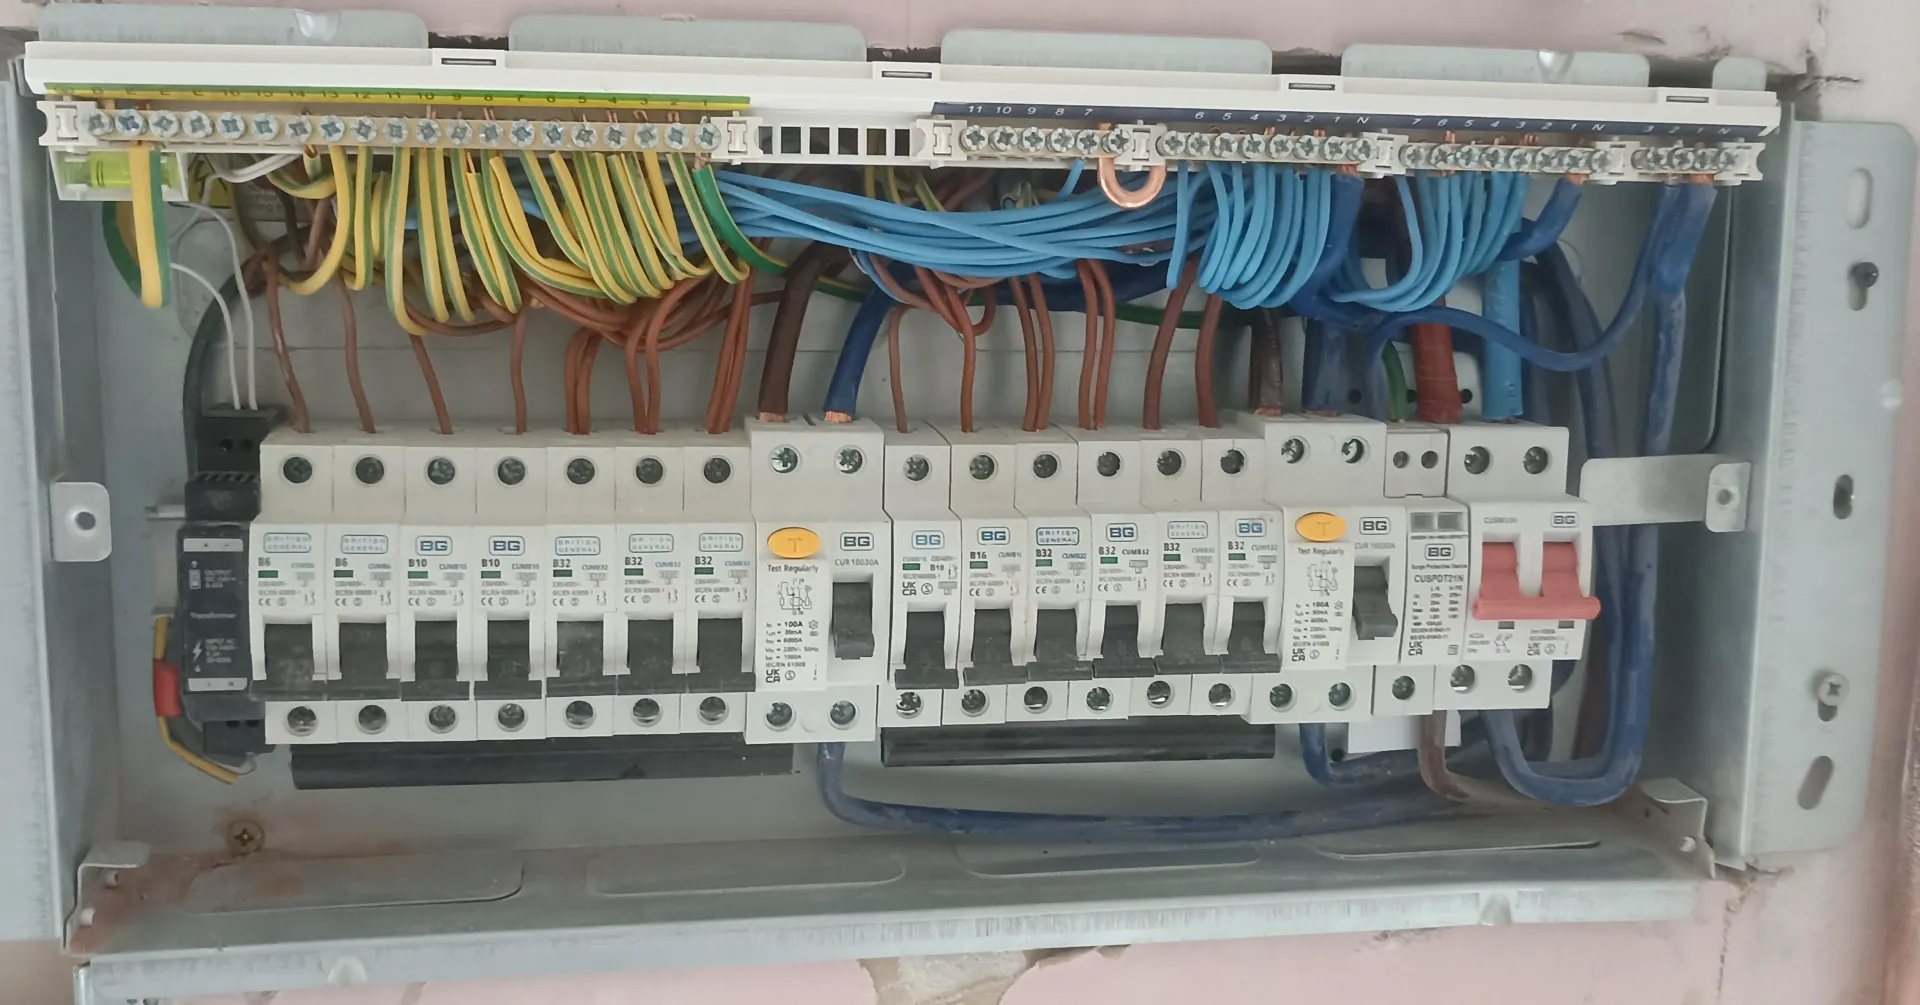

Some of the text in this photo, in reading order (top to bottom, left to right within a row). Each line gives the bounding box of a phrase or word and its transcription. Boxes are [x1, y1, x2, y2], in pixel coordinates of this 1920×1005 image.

[321, 90, 339, 98] 13
[353, 91, 371, 99] 12
[386, 91, 401, 99] 11
[417, 91, 435, 100] 10
[452, 91, 462, 101] 9
[484, 92, 493, 102] 8
[516, 94, 525, 102] 7
[578, 95, 587, 104] 5
[607, 96, 617, 104] 4
[640, 96, 648, 105] 3
[670, 97, 679, 106] 2
[968, 105, 1093, 117] 11 10 9 8 7
[1195, 111, 1370, 124] 6 5 4 3 2 1 N
[1412, 117, 1421, 126] 7
[1437, 118, 1447, 127] 6
[1464, 119, 1474, 128] 5
[1490, 120, 1500, 129] 4
[1515, 121, 1526, 129] 3
[1541, 122, 1551, 130] 2
[1592, 122, 1606, 131] N
[1644, 124, 1654, 133] 3
[1668, 125, 1680, 134] 2
[1717, 126, 1731, 135] N
[1553, 515, 1576, 525] BG
[1239, 523, 1262, 533] BG
[1316, 522, 1331, 537] T
[1363, 521, 1387, 531] BG
[981, 531, 1006, 541] BG
[1109, 527, 1134, 538] BG
[788, 537, 802, 553] T
[843, 536, 870, 547] BG
[915, 535, 941, 545] BG
[420, 541, 448, 551] BG
[493, 541, 520, 551] BG
[1098, 546, 1116, 555] B32
[1163, 543, 1180, 551] B32
[1228, 541, 1245, 550] B32
[970, 551, 987, 559] B16
[1036, 549, 1053, 557] B32
[1313, 548, 1345, 556] Regularly
[1428, 547, 1451, 557] BG
[258, 557, 271, 567] B6
[335, 557, 348, 567] B6
[408, 559, 428, 567] B10
[481, 559, 500, 567] B10
[553, 559, 571, 568] B32
[624, 557, 643, 566] B32
[695, 556, 712, 565] B32
[767, 564, 819, 574] Test Regularly
[1414, 575, 1464, 583] CUSPDT21N
[1408, 648, 1423, 656] CA
